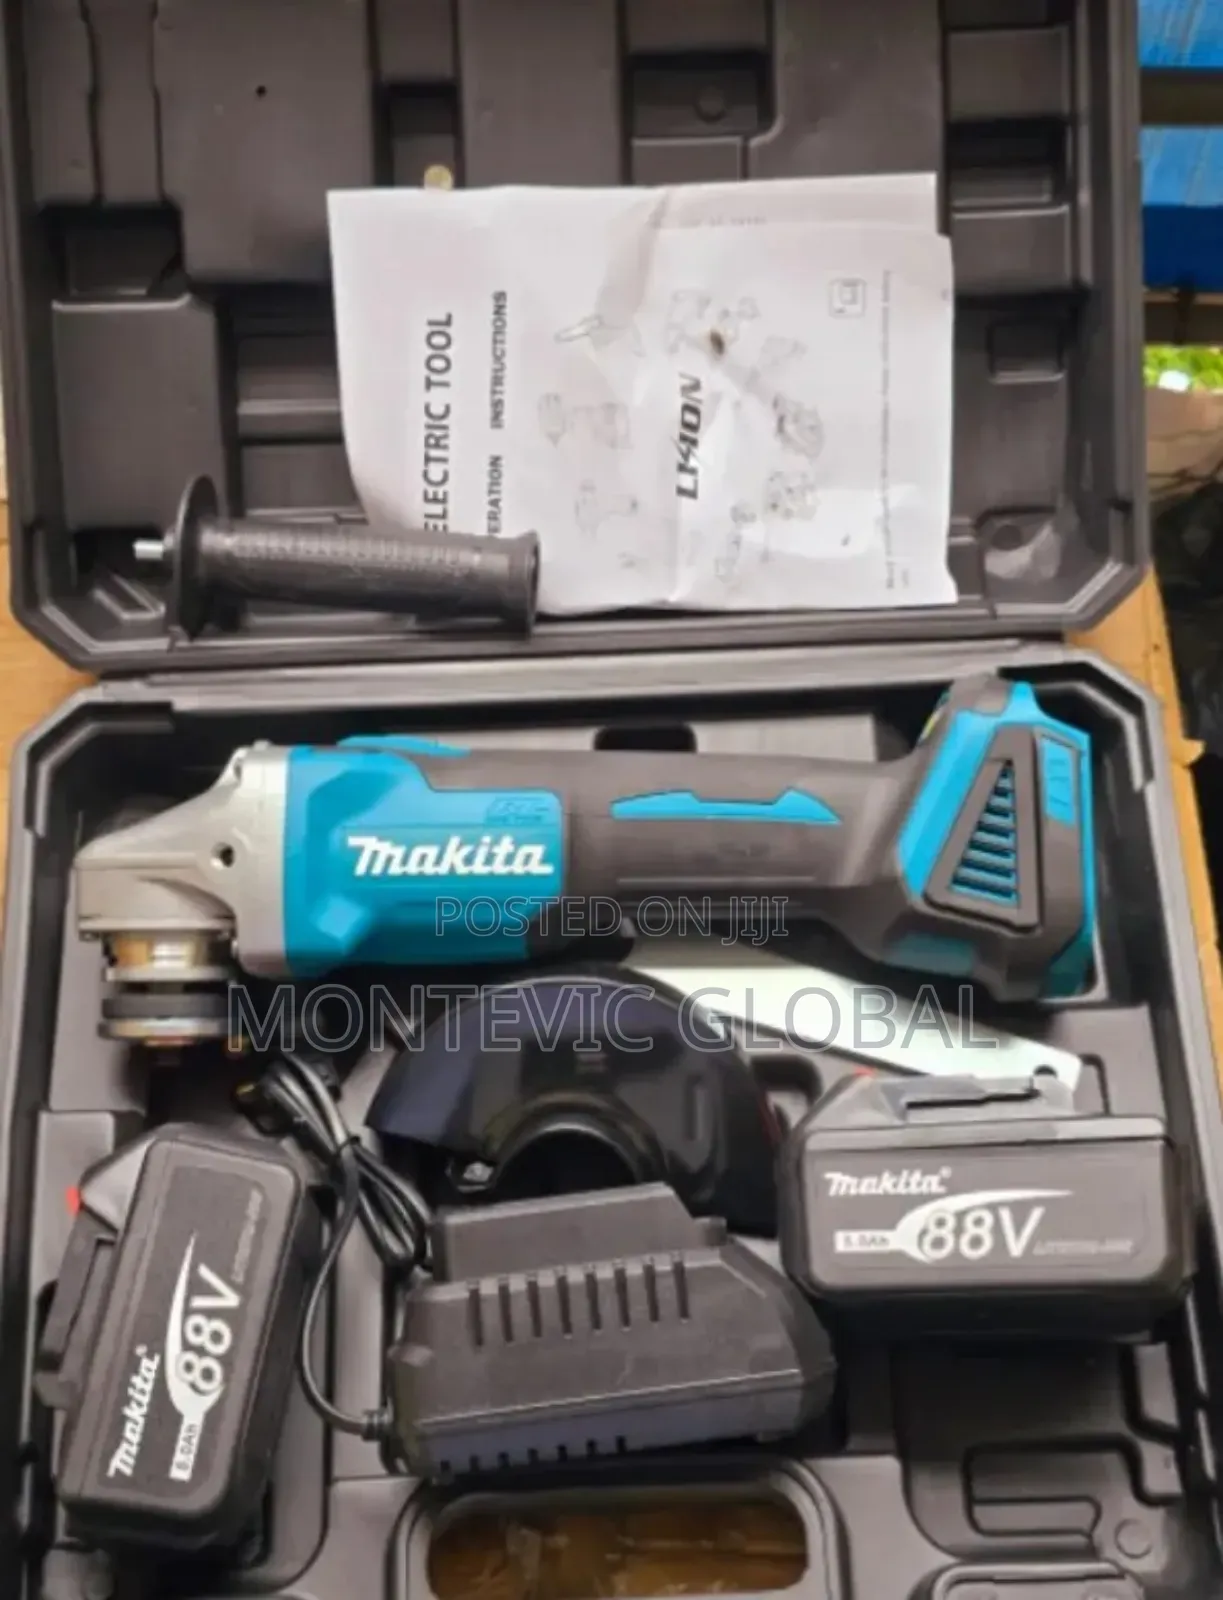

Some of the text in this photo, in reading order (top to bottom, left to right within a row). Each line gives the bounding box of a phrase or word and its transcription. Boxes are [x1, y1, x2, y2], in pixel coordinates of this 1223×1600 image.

[422, 312, 454, 533] ELECTRIC TOOL
[486, 290, 508, 536] ERATION INSTRUCTIONS
[347, 835, 554, 877] makita
[918, 1205, 1046, 1260] 88V
[175, 1263, 241, 1397] 88V
